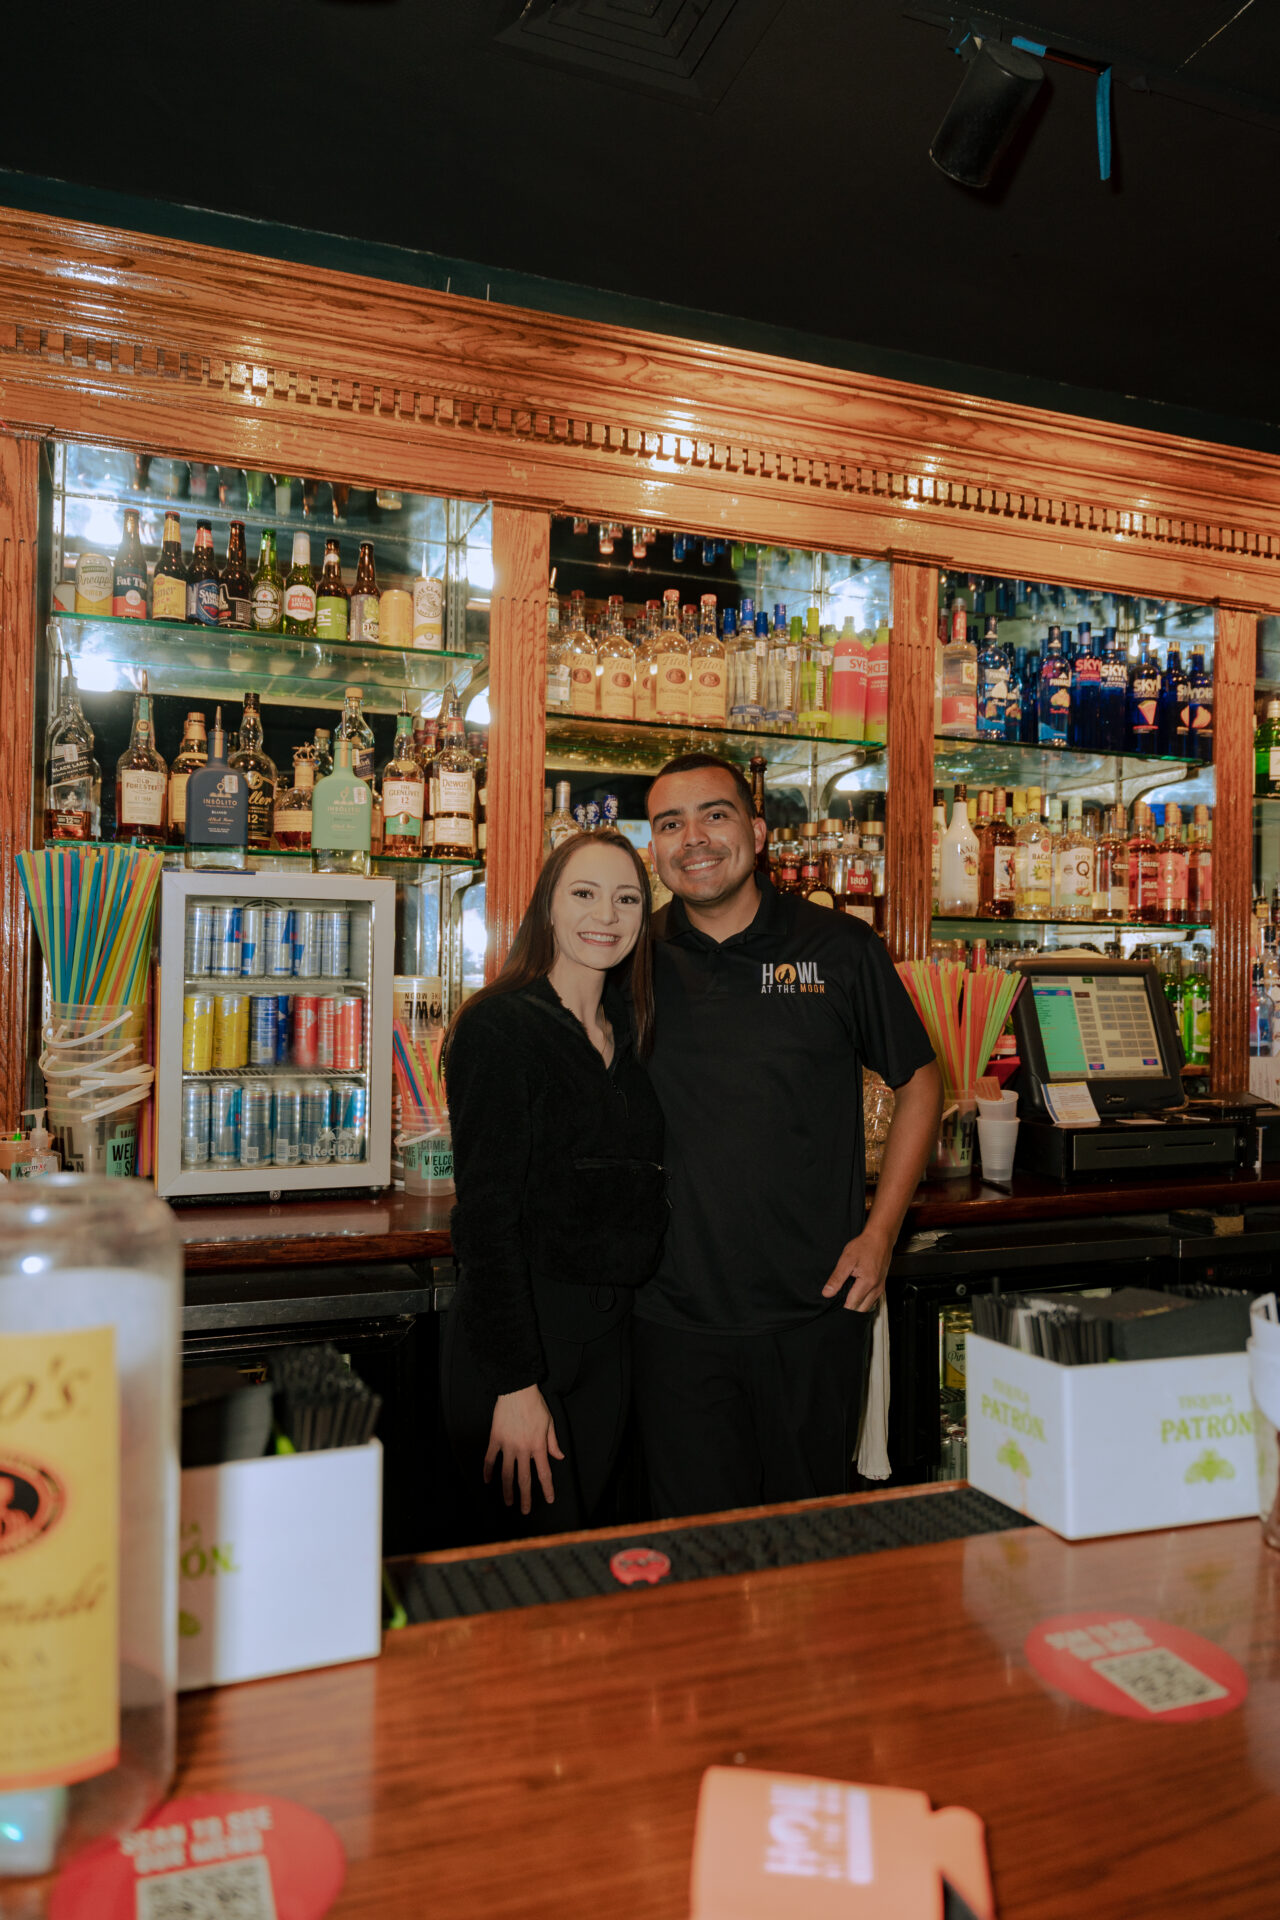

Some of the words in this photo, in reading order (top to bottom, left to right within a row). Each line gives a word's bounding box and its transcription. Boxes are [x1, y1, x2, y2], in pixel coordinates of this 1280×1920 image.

[116, 576, 131, 586] Fat
[200, 589, 217, 600] SAMU
[317, 608, 332, 626] IPA
[849, 657, 867, 672] SVE
[72, 760, 90, 768] LABEL
[248, 790, 272, 805] ller
[401, 796, 409, 804] 12
[65, 816, 74, 825] 12
[1076, 860, 1090, 880] Q
[850, 876, 869, 886] 1800
[762, 962, 824, 985] HOWL
[761, 984, 773, 994] AT
[777, 984, 796, 993] THE
[800, 983, 825, 994] MOON
[404, 1000, 442, 1021] OWL
[313, 1143, 337, 1157] Red
[337, 1143, 360, 1156] Bull
[424, 1155, 453, 1166] WELCO
